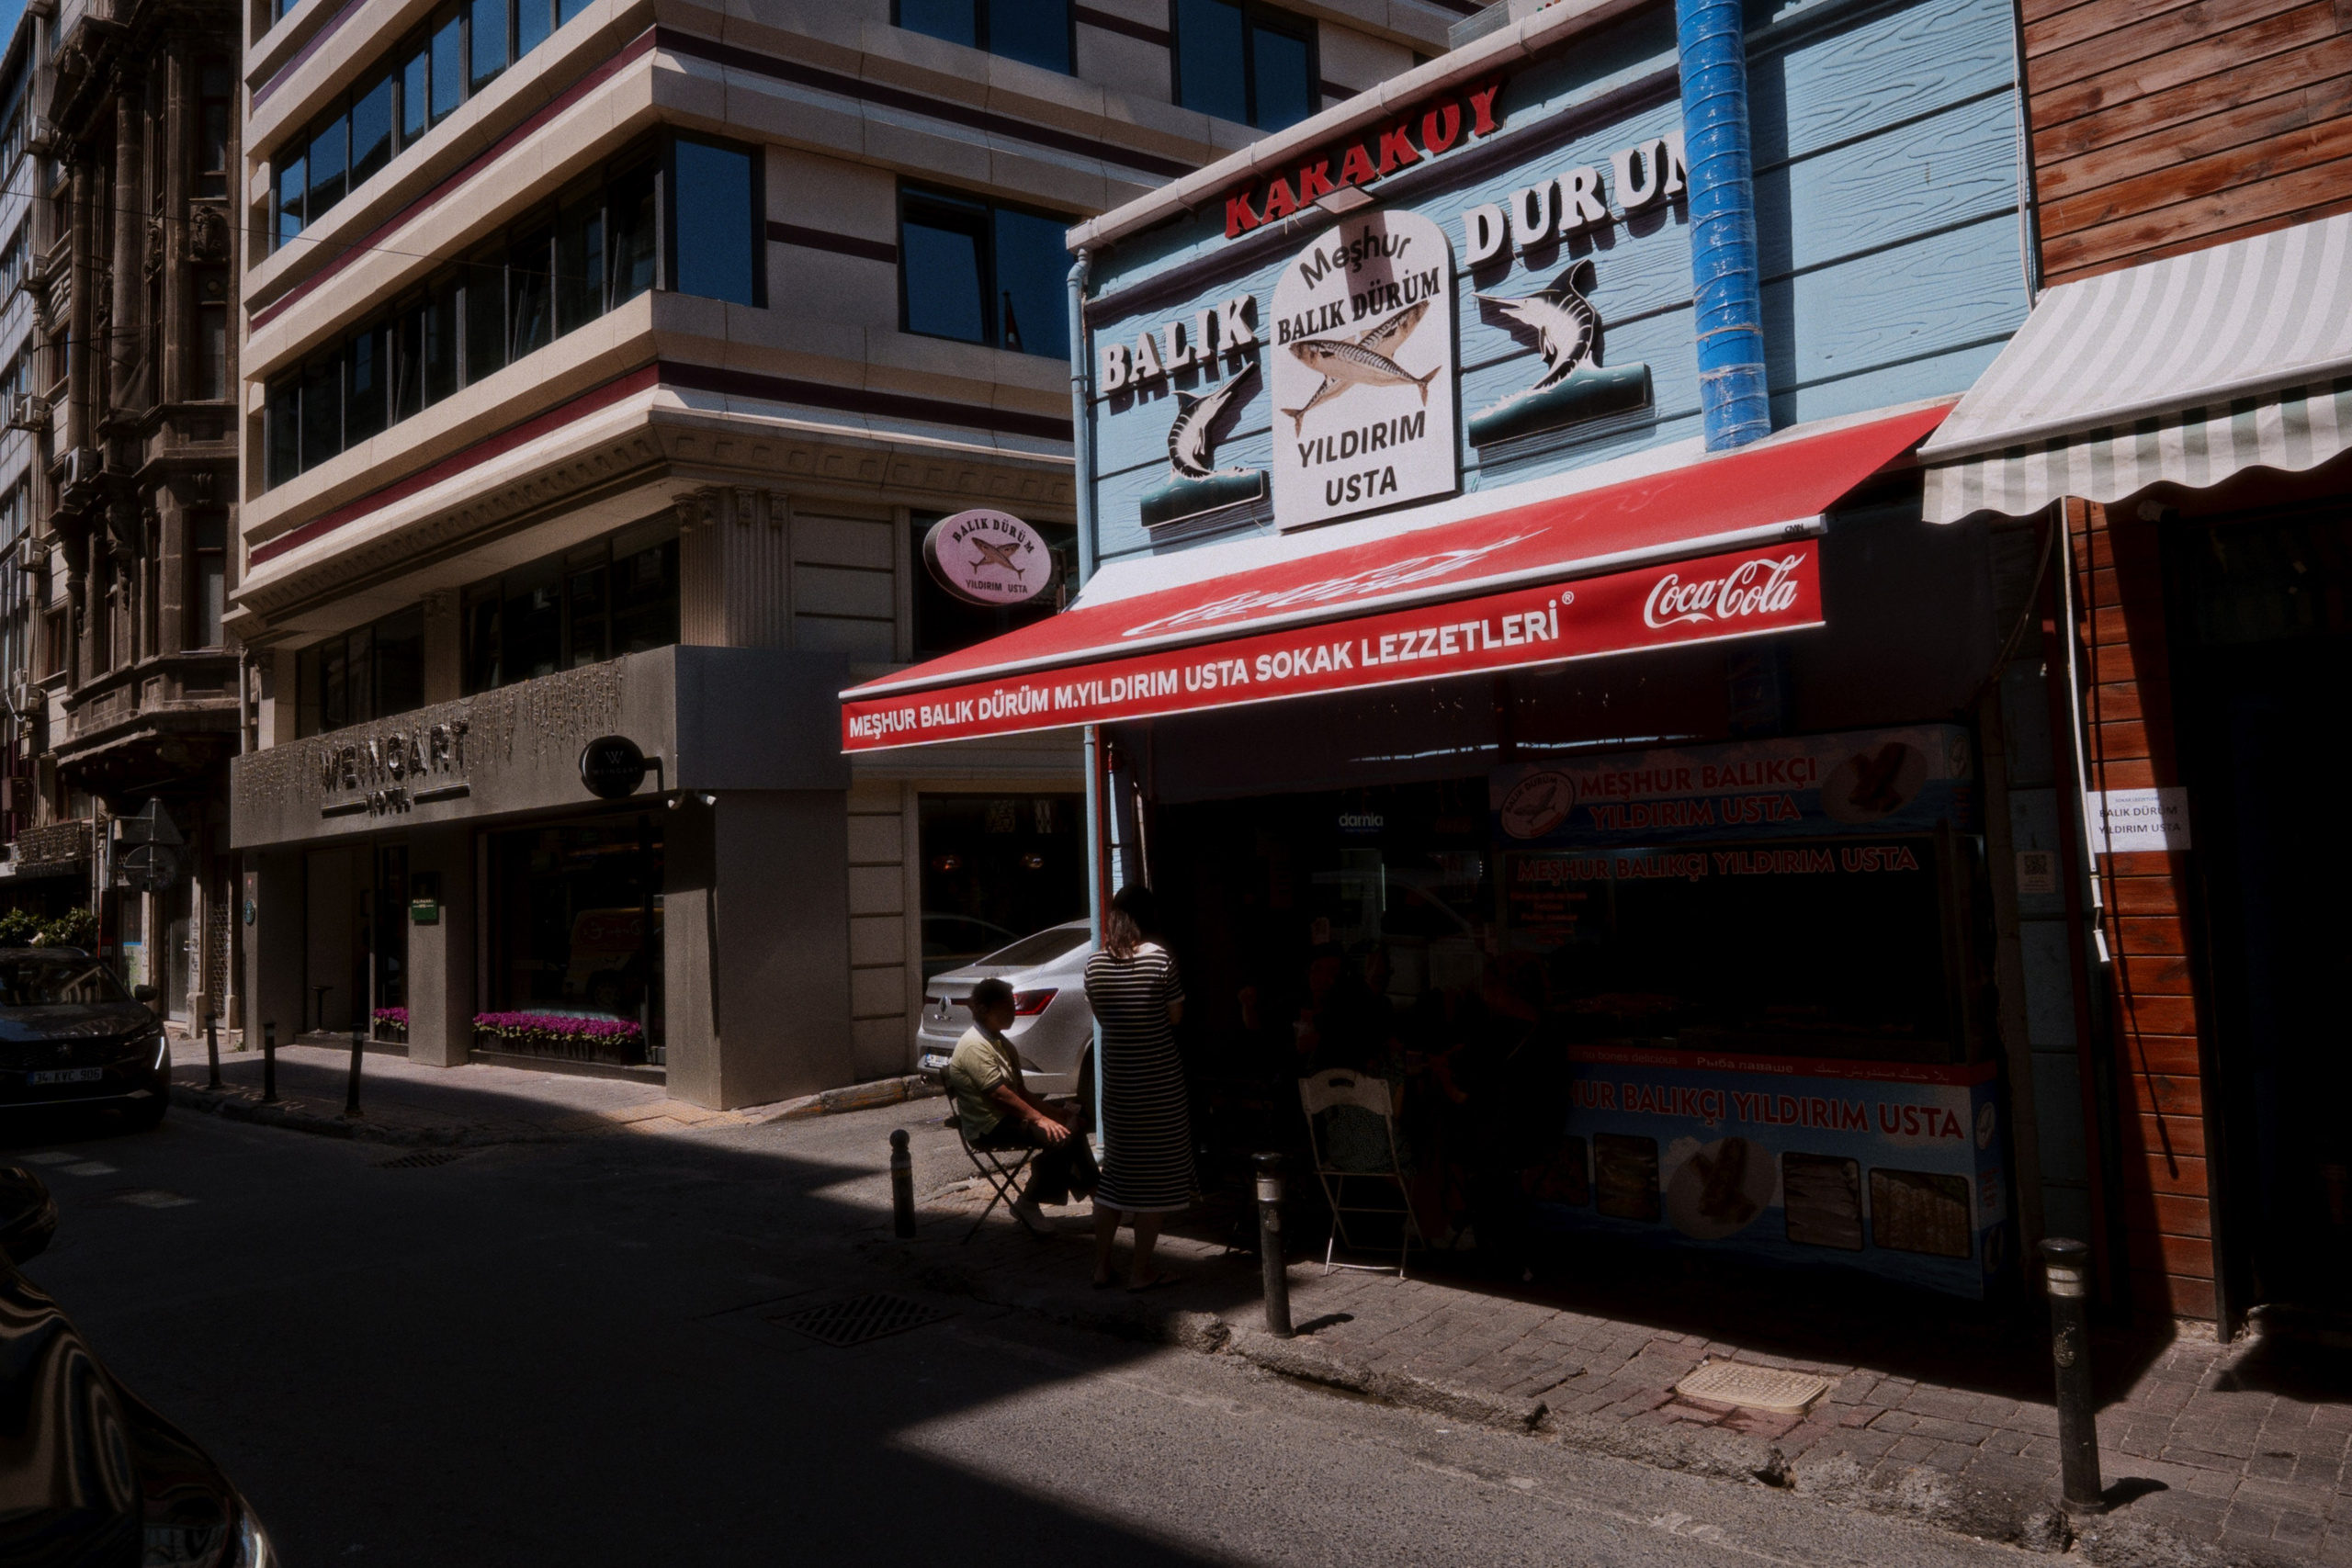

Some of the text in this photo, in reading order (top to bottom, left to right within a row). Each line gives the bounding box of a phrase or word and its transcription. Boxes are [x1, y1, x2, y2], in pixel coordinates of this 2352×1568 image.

[1299, 226, 1411, 291] Meşhur
[1100, 294, 1258, 393] BALIK
[1277, 306, 1346, 346] BALIK
[1297, 410, 1427, 468] YILDIRIM
[1325, 468, 1397, 507] USTA
[951, 517, 1035, 555] BALIK DÜRÜM
[966, 580, 1028, 594] YILDIRIM USTA
[1643, 552, 1807, 629] Coca-Cola
[849, 599, 1559, 740] MEŞHUR BALIK DÜRÜM M.YILDIRIM USTA SOKAK LEZZETLERİ
[319, 718, 469, 794] WEINGART
[1580, 757, 1816, 801] MEŞHUR BALIKÇI
[1338, 811, 1385, 828] damla
[1588, 799, 1715, 831] YILDIRIM
[1722, 794, 1802, 825] USTA
[2098, 822, 2181, 834] YILDIRIM USTA
[2099, 804, 2178, 818] BALIK DÜRÜM
[1518, 845, 1919, 887] MEŞHUR BALIKÇI YILDIRIM USTA
[1597, 1051, 1629, 1063] bones
[1632, 1053, 1679, 1066] delicious
[1696, 1055, 1794, 1074] Рыба лаваше
[1623, 1083, 1725, 1125] BALIKÇI
[1733, 1092, 1871, 1133] YILDIRIM
[1878, 1103, 1964, 1140] USTA
